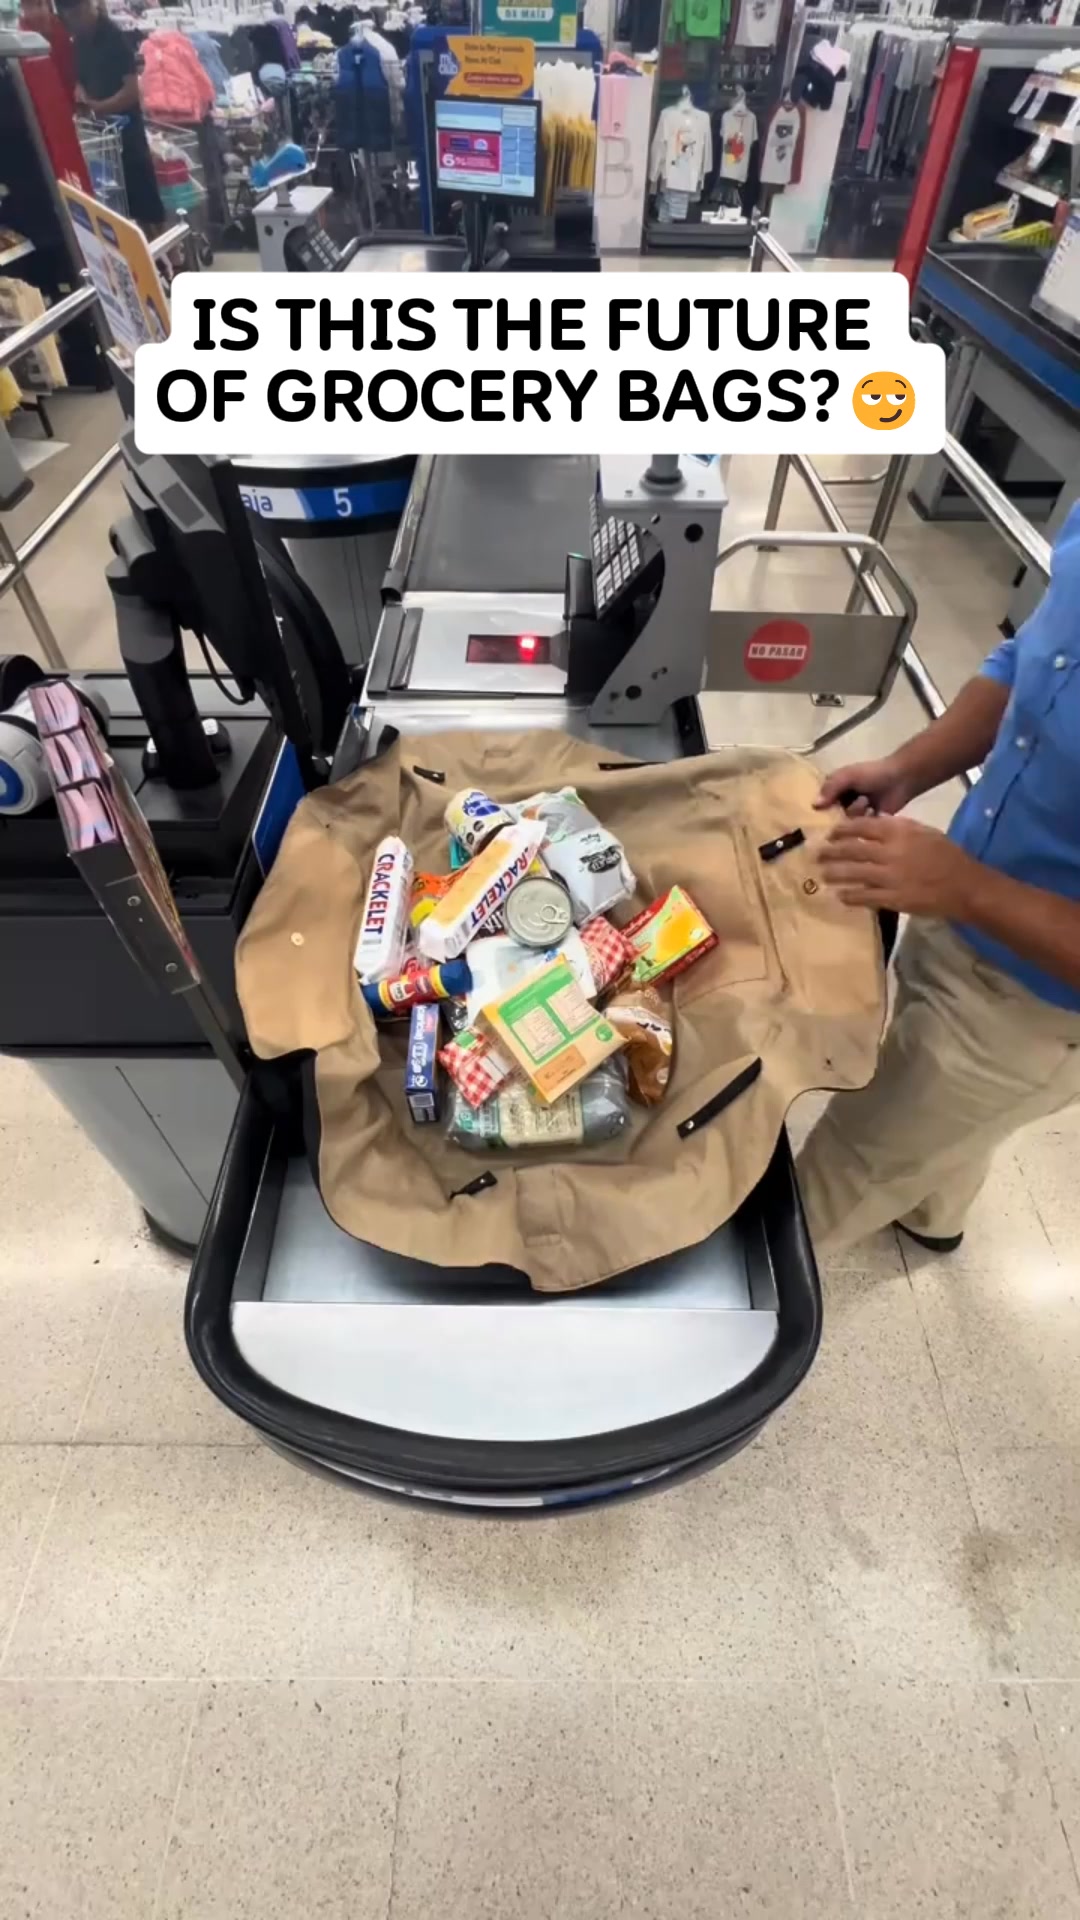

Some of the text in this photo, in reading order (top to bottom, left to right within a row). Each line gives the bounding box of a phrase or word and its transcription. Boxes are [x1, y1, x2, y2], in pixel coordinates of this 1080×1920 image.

[241, 487, 352, 517] aja 5
[751, 645, 805, 657] NO PASAR
[364, 853, 396, 935] CRACKELET
